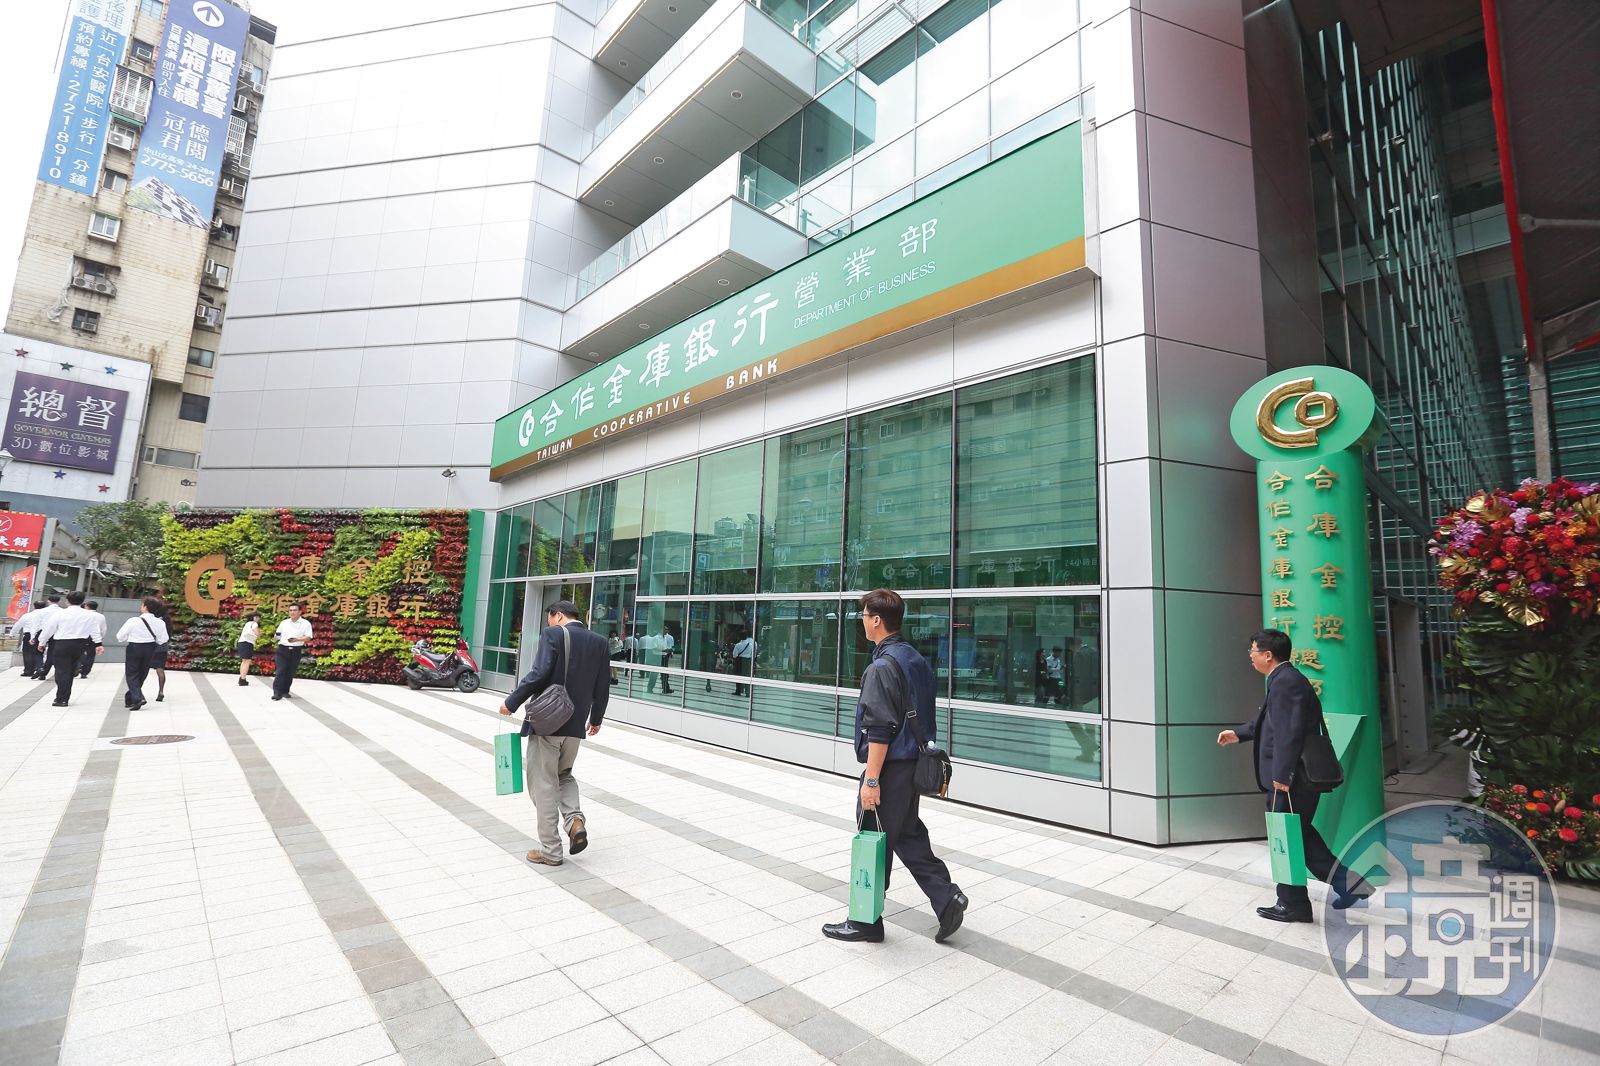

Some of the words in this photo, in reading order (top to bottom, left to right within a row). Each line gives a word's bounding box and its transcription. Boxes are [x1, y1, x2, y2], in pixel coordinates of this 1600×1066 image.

[140, 153, 214, 188] 2775-5656
[793, 292, 859, 329] DEPARTMENT
[859, 285, 876, 302] OF
[877, 260, 937, 295] BUSINESS
[794, 217, 939, 309] 營業部
[539, 292, 780, 438] 合作金庫銀行
[18, 386, 118, 431] 總督
[536, 438, 574, 461] TAIWAN
[593, 391, 692, 438] COOPERATIVE
[725, 358, 779, 390] BANK
[239, 552, 432, 585] 合庫金控
[1304, 464, 1346, 641] 合庫金控
